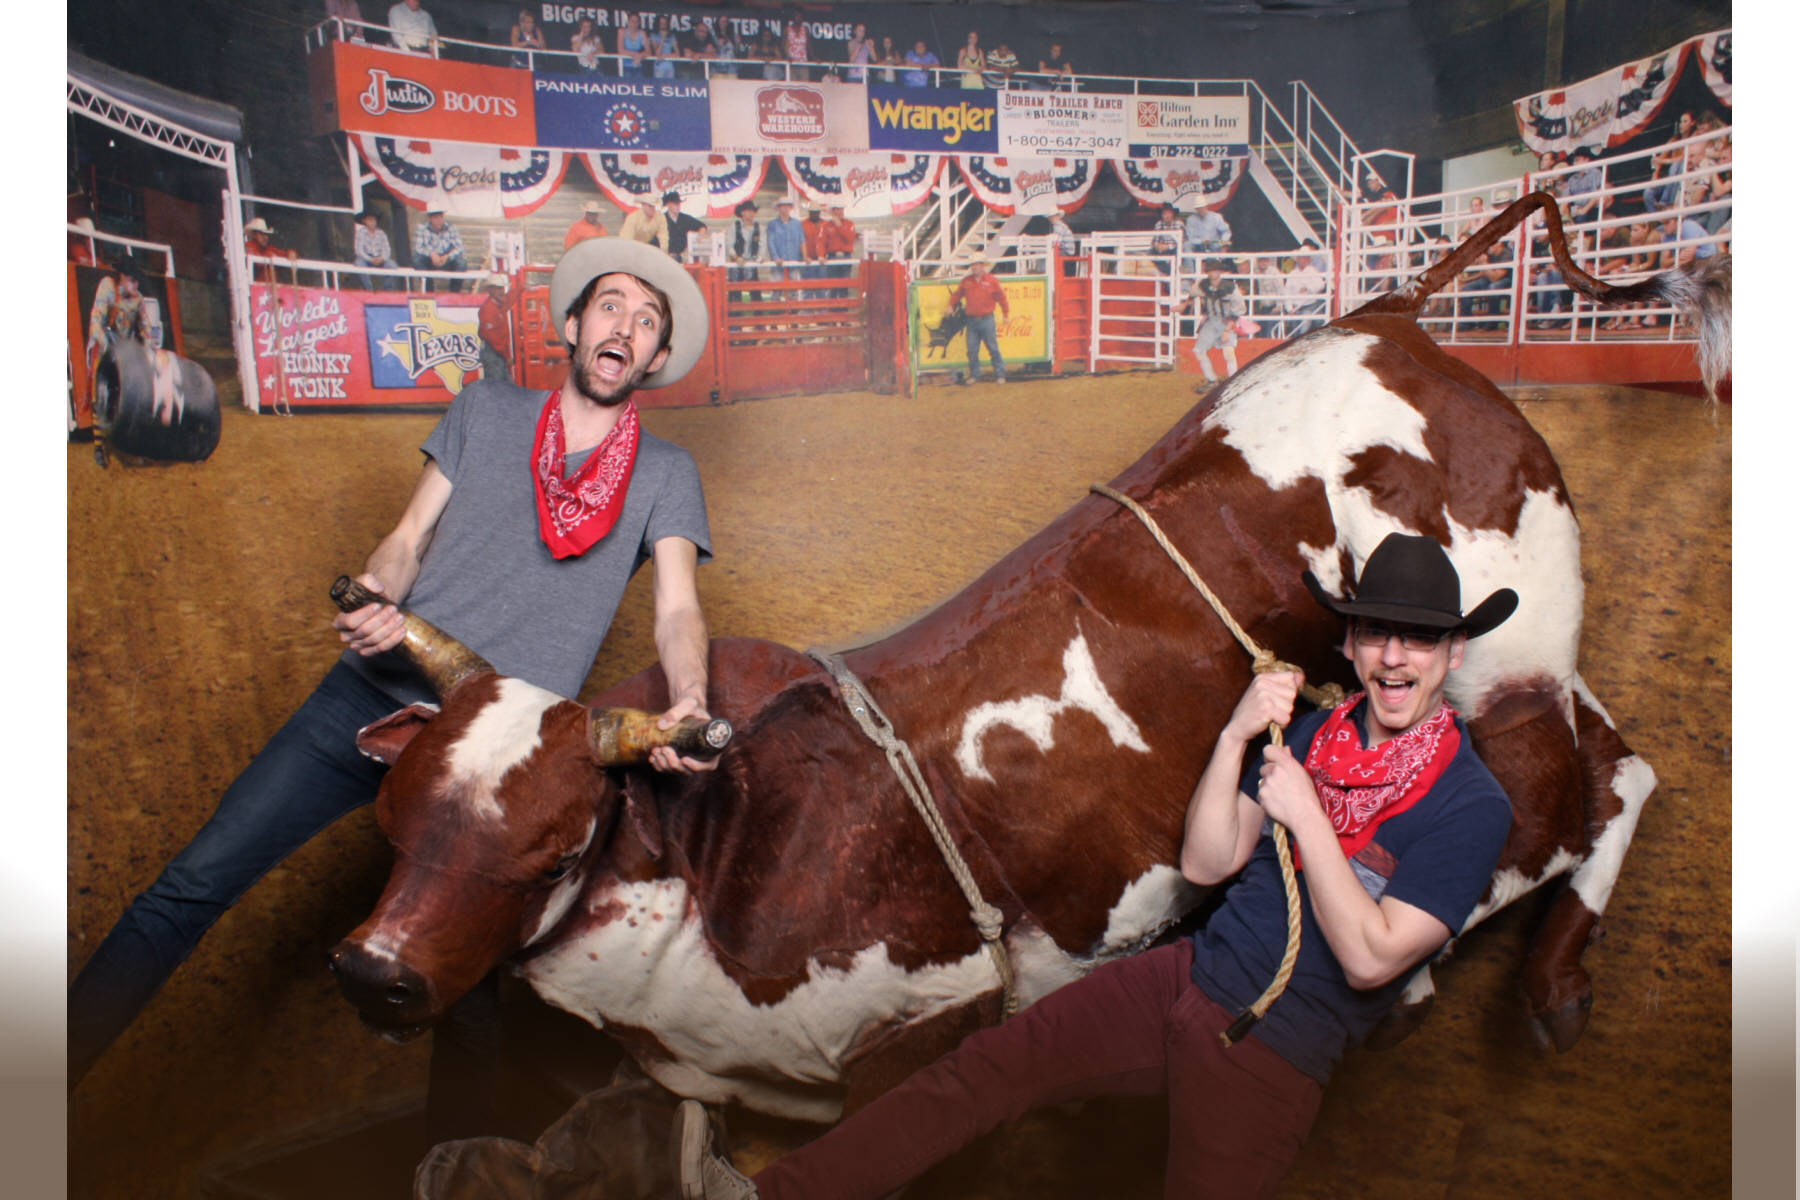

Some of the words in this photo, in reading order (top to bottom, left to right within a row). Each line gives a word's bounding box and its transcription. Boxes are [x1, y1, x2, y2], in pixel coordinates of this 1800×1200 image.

[541, 3, 609, 27] BIGGER
[702, 16, 760, 36] BTER
[360, 68, 430, 117] Justin
[443, 91, 518, 118] BOOTS
[535, 79, 654, 98] PANHANDLE
[661, 85, 708, 100] SLIM
[1005, 93, 1045, 108] DURHAM
[1049, 95, 1089, 109] TRAILER
[1094, 97, 1123, 110] RANCH
[1159, 101, 1192, 113] Hilton
[768, 114, 817, 125] WESTERN
[871, 97, 995, 145] Wrangler
[1033, 109, 1089, 120] BLOOMER
[1160, 114, 1210, 128] Garden
[1214, 114, 1237, 128] Inn
[762, 123, 823, 135] WAREHOUSE
[1007, 135, 1122, 148] 1-800-647-3047
[440, 165, 498, 192] Coors
[654, 165, 704, 191] Coors
[845, 166, 888, 189] Coors
[1015, 169, 1053, 188] Coors
[1165, 169, 1201, 187] Coors
[255, 295, 340, 334] World's
[259, 314, 348, 357] Largest
[394, 323, 483, 380] TEXAS
[283, 352, 352, 375] HONKY
[288, 376, 347, 399] TONK
